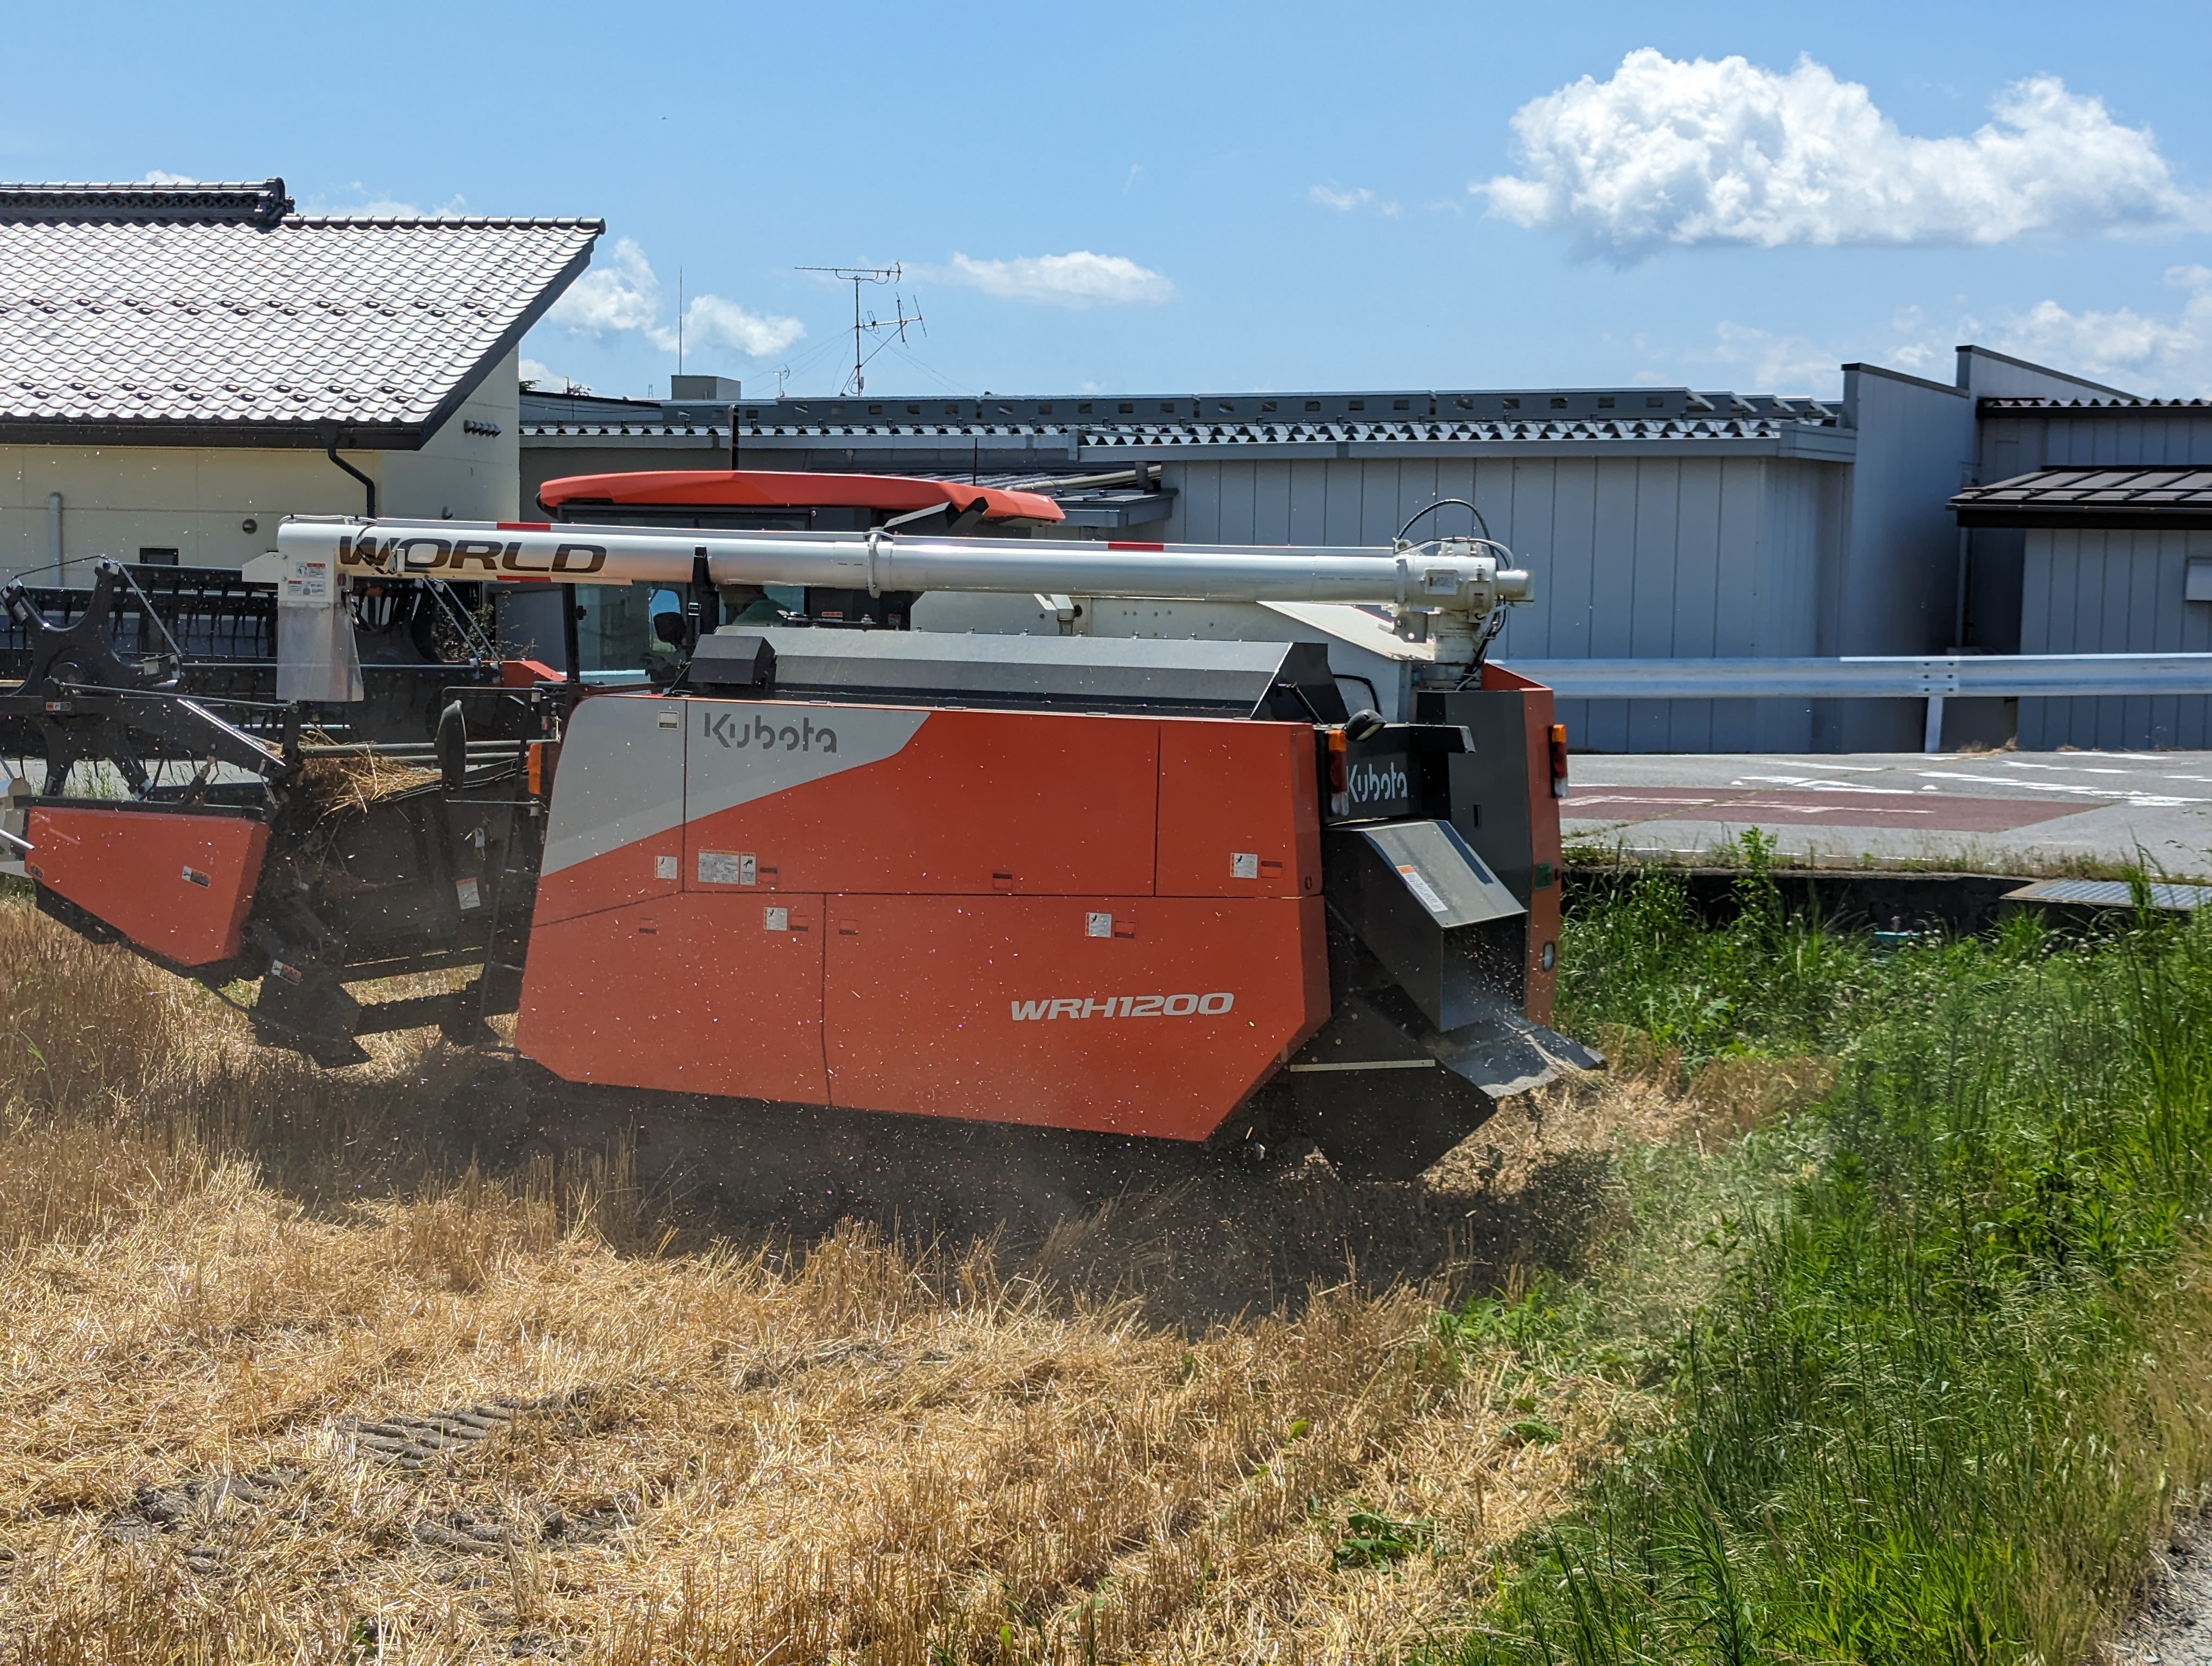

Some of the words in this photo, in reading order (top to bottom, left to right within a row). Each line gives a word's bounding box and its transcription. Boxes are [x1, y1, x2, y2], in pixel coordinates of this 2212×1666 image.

[339, 535, 607, 573] WORLD
[704, 713, 837, 753] Kubota
[1346, 762, 1407, 803] Kubota
[1011, 992, 1234, 1021] WRH1200
